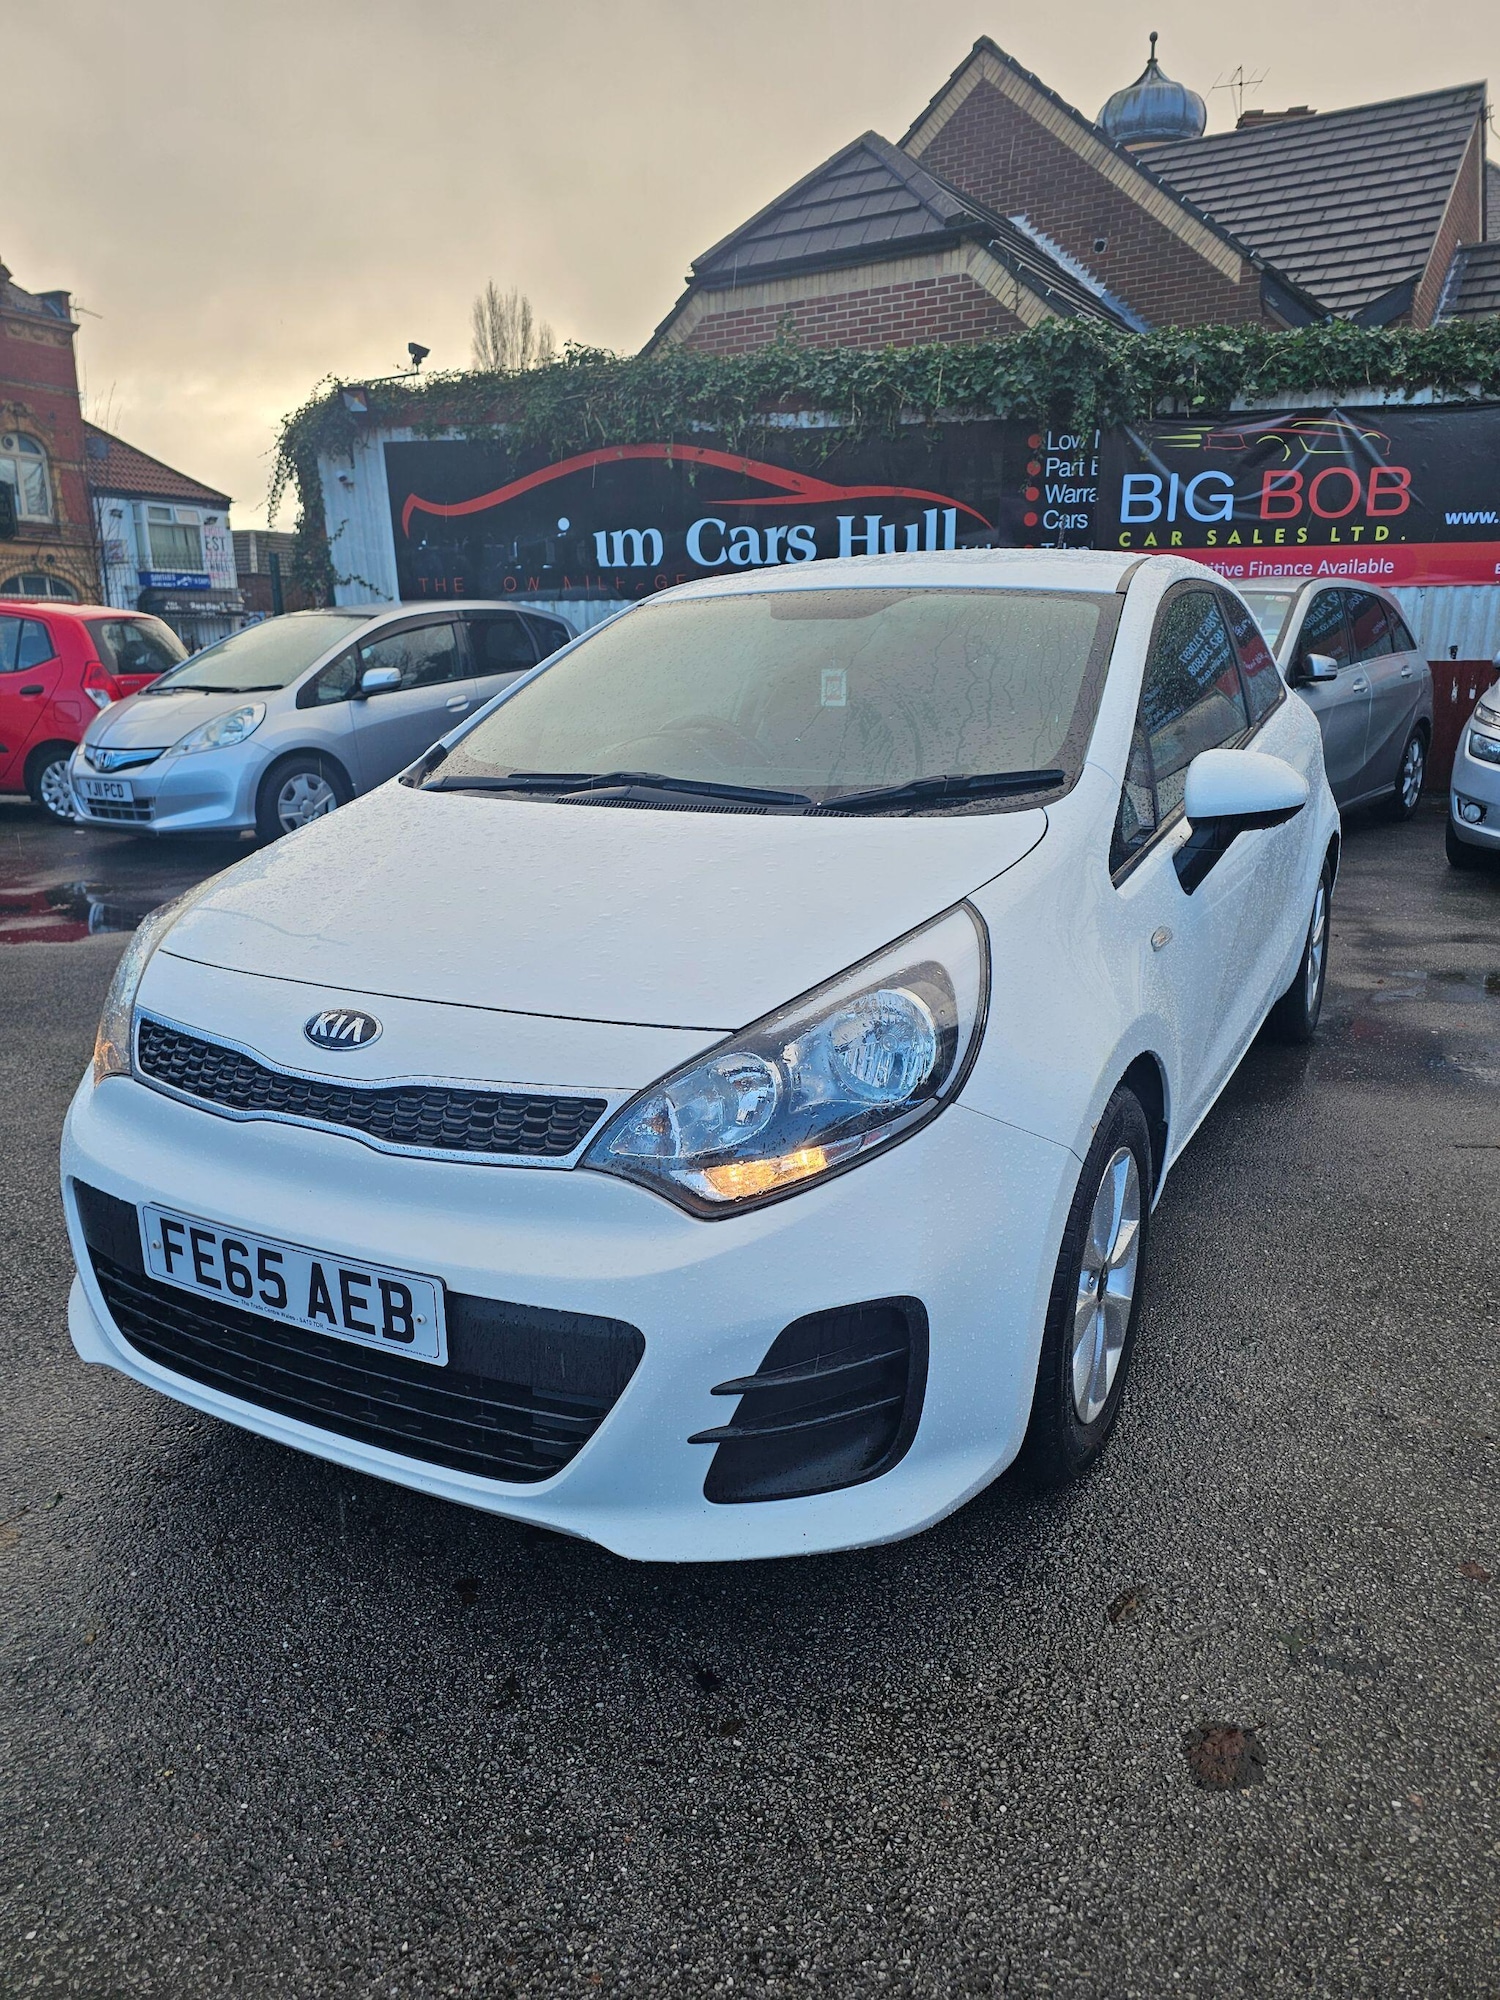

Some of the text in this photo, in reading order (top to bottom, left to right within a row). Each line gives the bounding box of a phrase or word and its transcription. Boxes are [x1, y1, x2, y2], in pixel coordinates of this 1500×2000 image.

[1046, 457, 1085, 478] Part
[1119, 466, 1412, 524] BIG BOB
[1042, 509, 1089, 530] Cars
[1444, 511, 1499, 525] www.
[686, 517, 817, 567] Cars
[836, 508, 957, 559] Hull
[1118, 525, 1406, 547] CAR SALES LTD.
[1249, 560, 1314, 577] Finance
[1317, 558, 1394, 575] Available
[418, 577, 465, 593] THE
[104, 783, 125, 799] PCD
[311, 1012, 366, 1042] KIA
[160, 1217, 416, 1344] FE65 AEB
[241, 1299, 250, 1307] The
[250, 1301, 264, 1311] Trade
[264, 1306, 280, 1316] Centre
